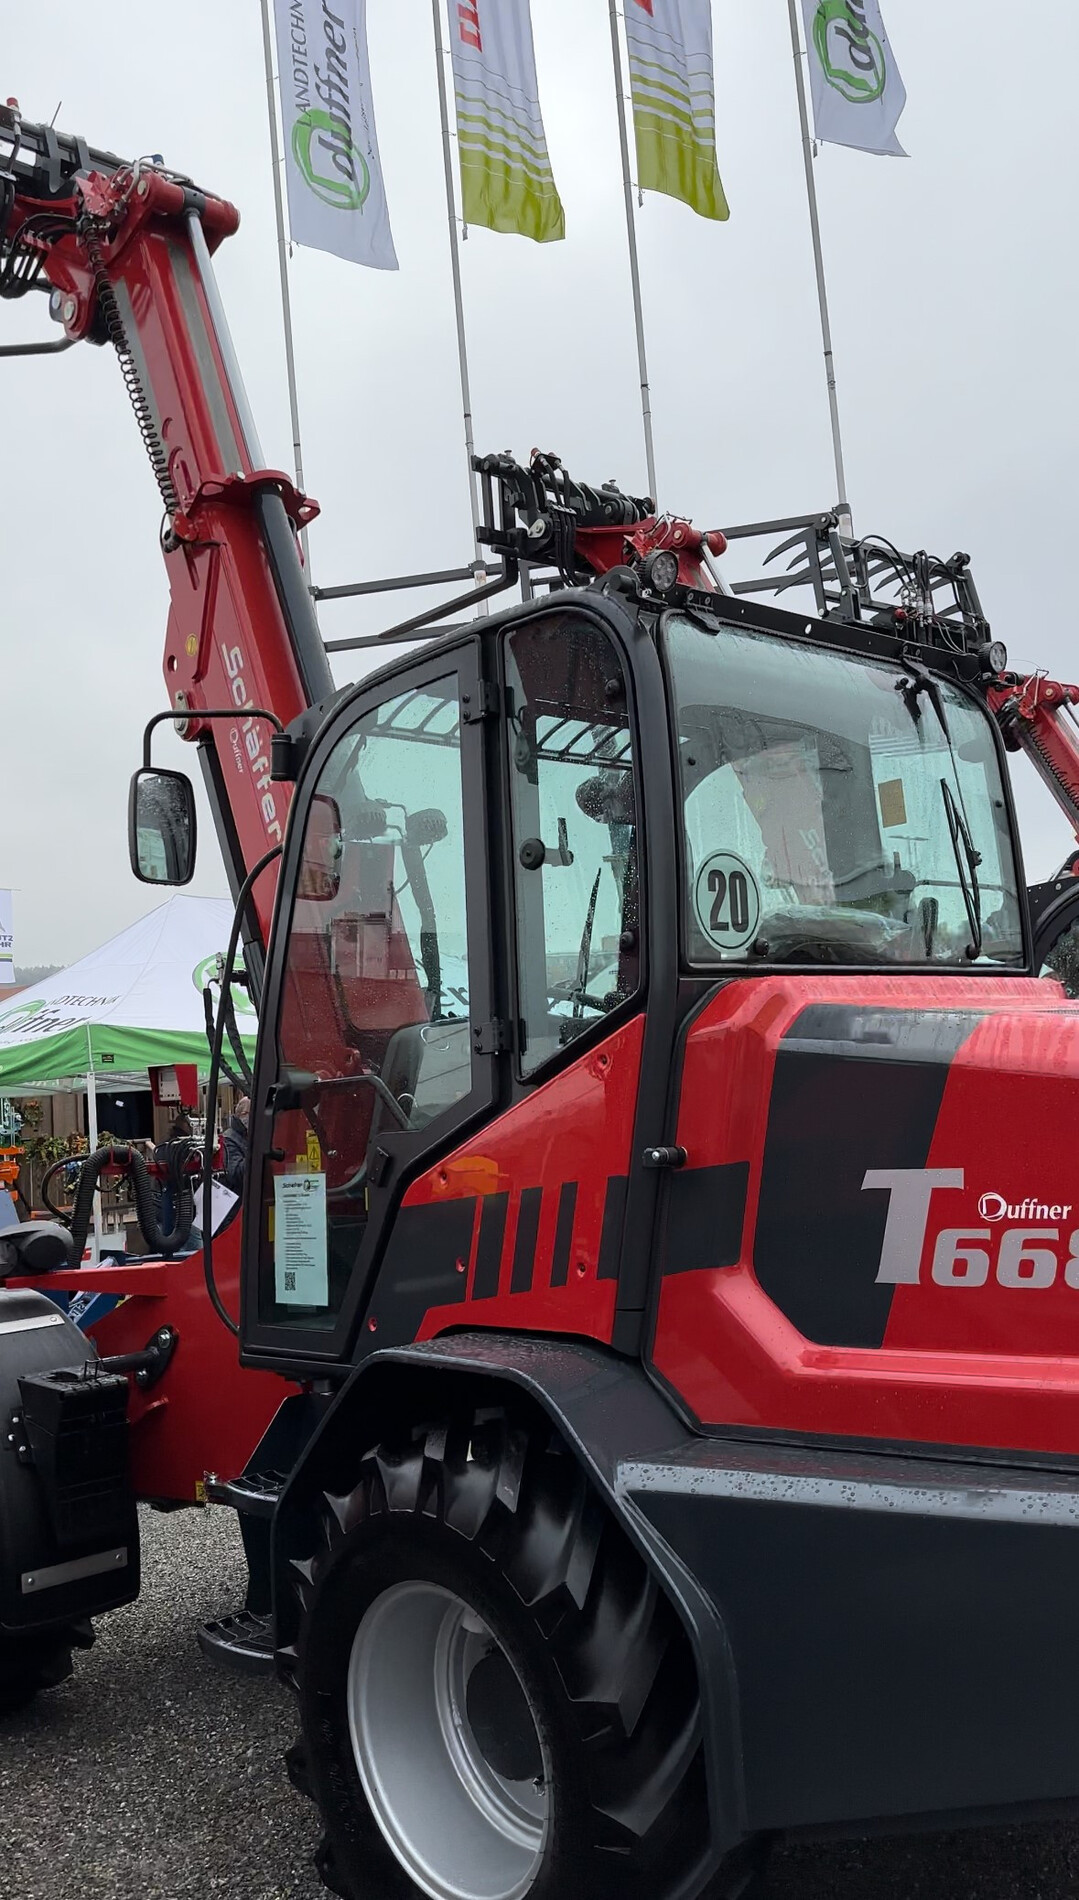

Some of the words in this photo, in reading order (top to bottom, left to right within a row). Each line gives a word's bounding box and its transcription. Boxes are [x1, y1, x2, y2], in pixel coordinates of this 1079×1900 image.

[313, 0, 354, 182] duffner
[707, 869, 750, 933] 20
[861, 1167, 1079, 1289] T66
[978, 1192, 1072, 1222] Duffner
